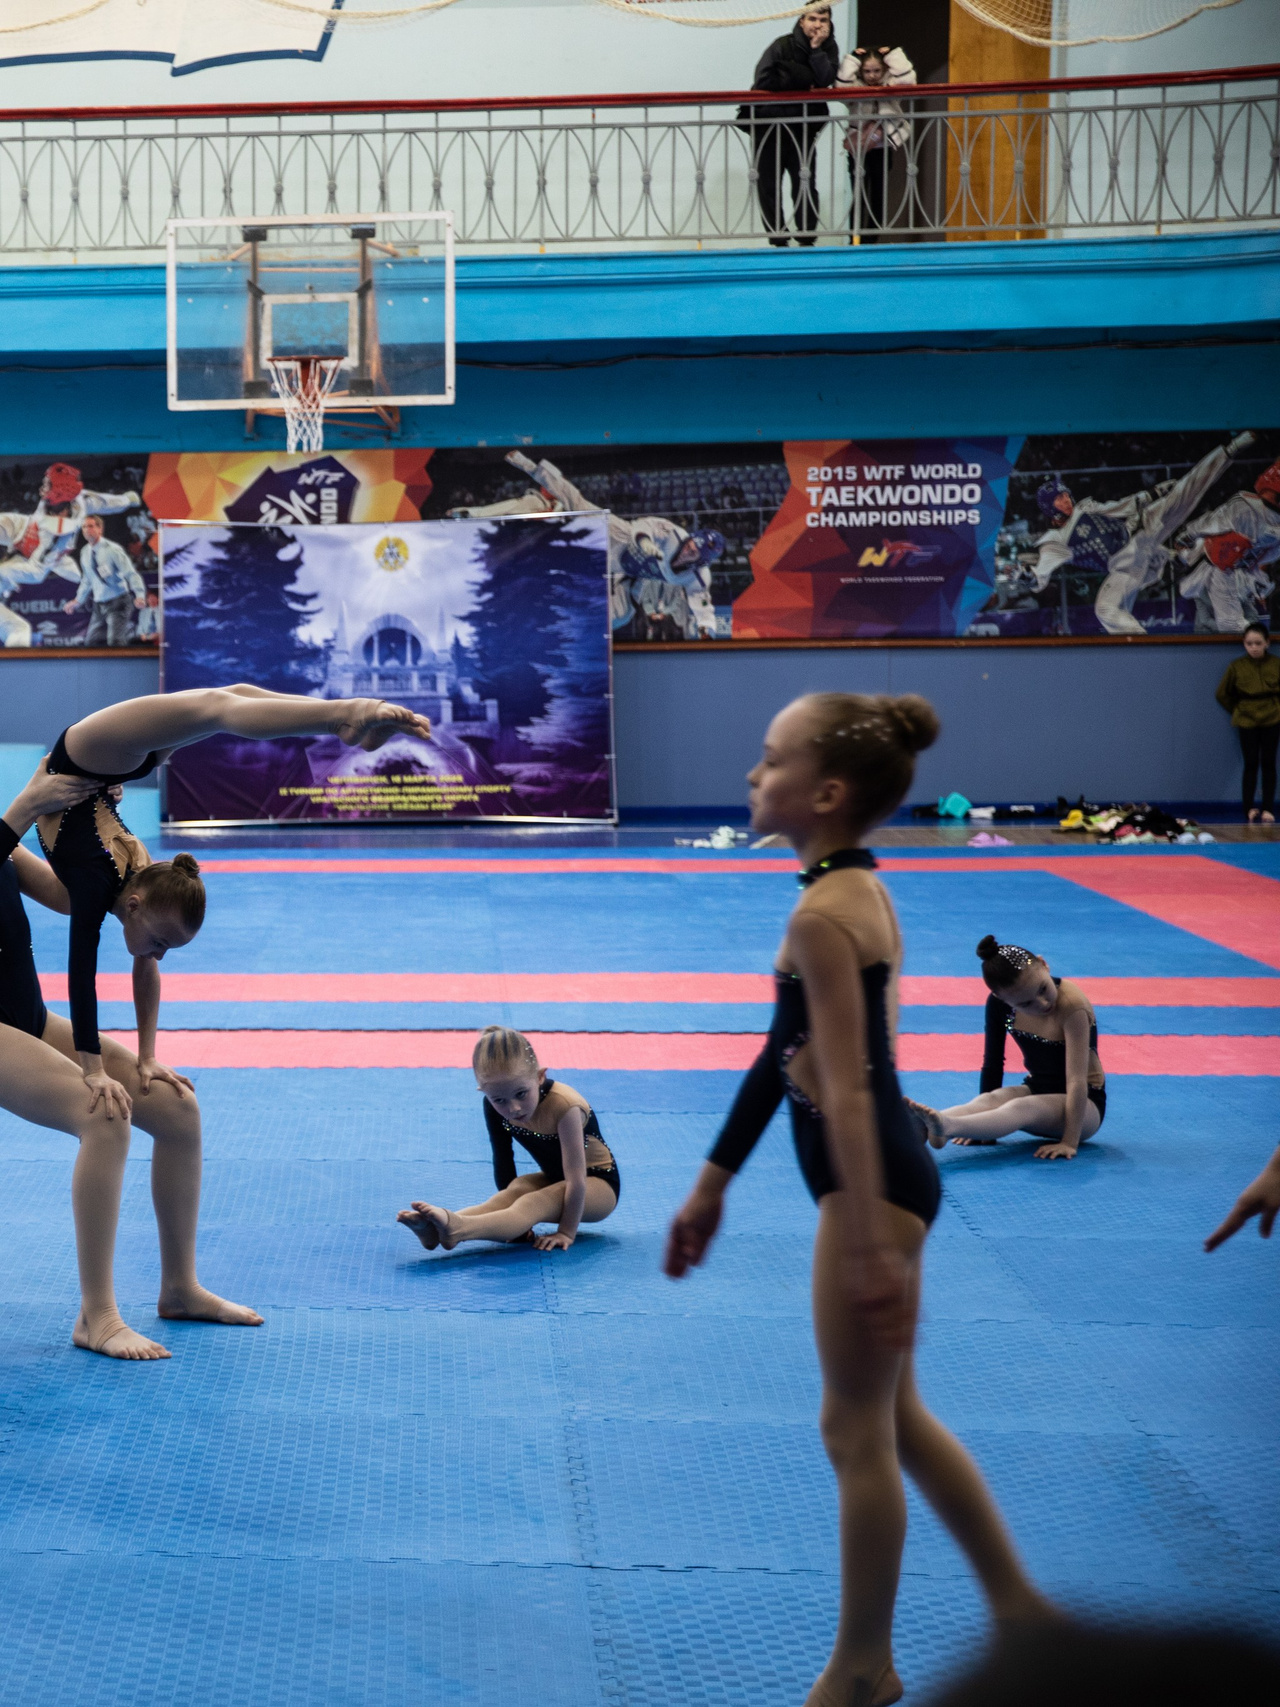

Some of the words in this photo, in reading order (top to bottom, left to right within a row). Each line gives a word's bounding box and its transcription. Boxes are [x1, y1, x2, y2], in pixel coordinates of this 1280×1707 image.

[806, 466, 857, 481] 2015
[863, 464, 905, 481] WTF
[910, 463, 982, 479] WORLD
[805, 483, 982, 507] TAEKWONDO
[805, 509, 980, 527] CHAMPIONSHIPS
